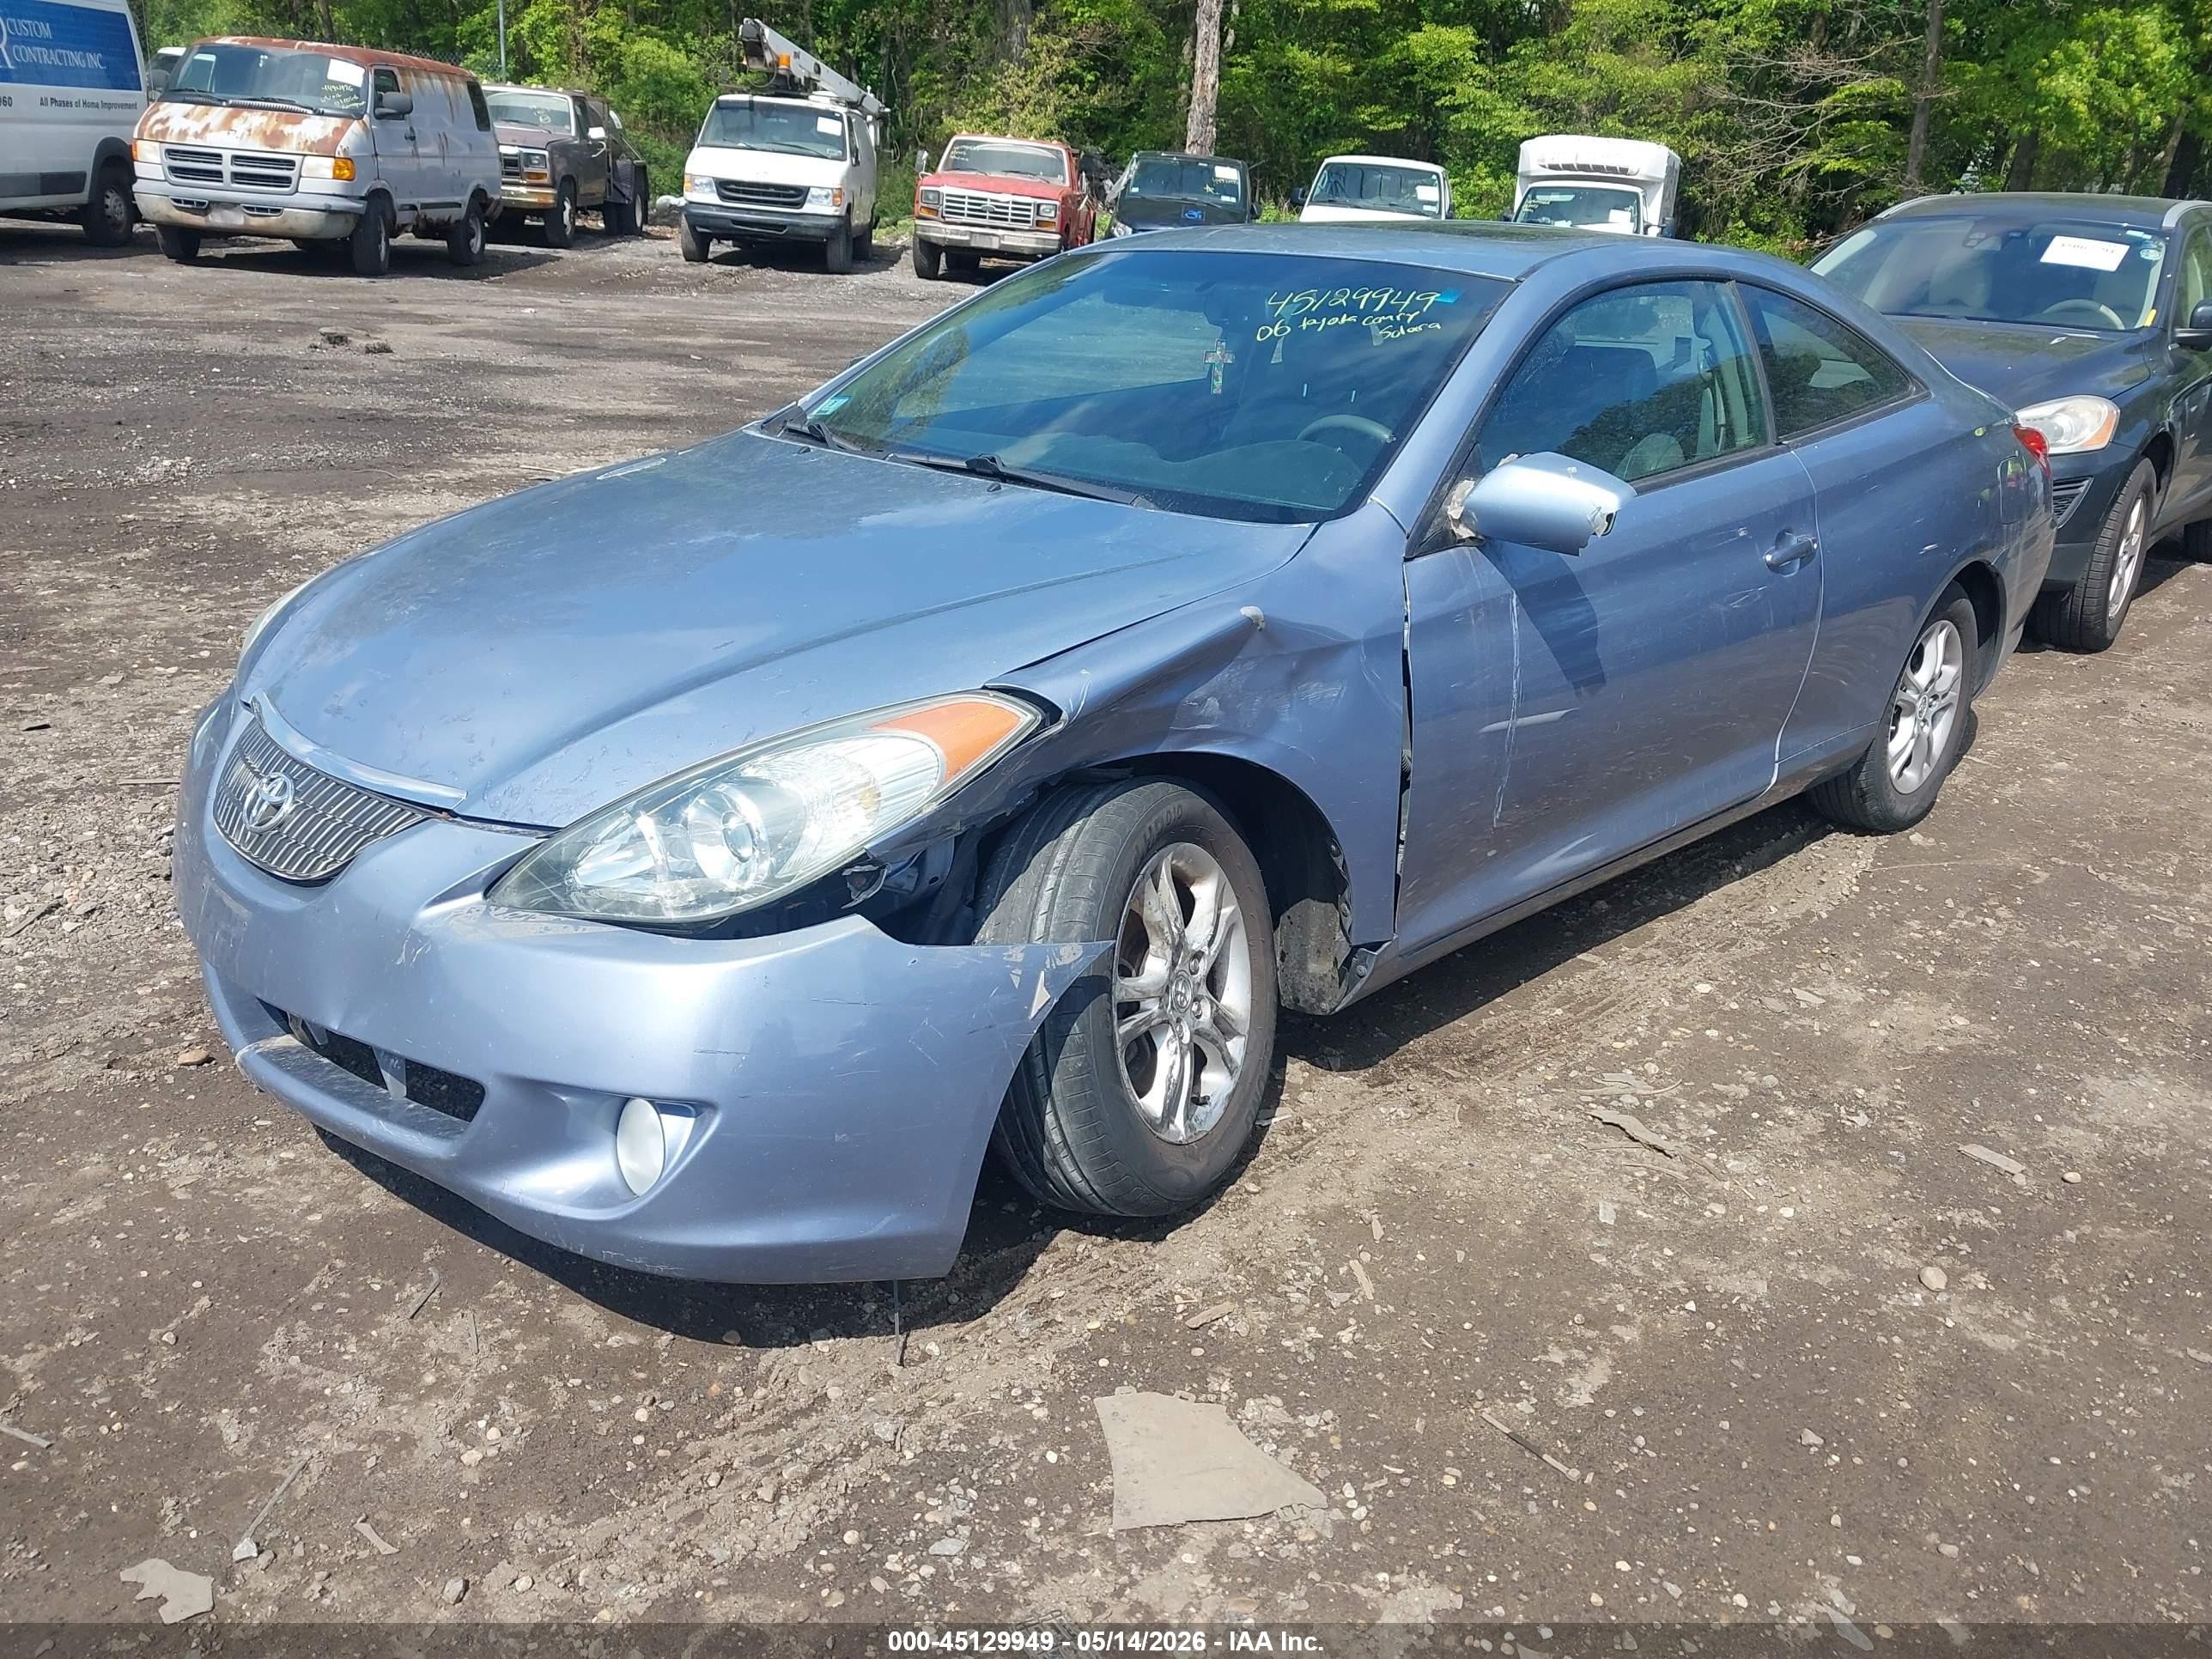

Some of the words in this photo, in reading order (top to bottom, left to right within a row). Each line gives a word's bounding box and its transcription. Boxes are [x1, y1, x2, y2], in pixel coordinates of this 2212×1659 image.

[7, 18, 52, 40] CUSTOM
[13, 45, 86, 69] CONTRACTING
[86, 52, 106, 70] INC.
[0, 95, 13, 107] 60
[40, 96, 48, 106] All
[50, 97, 73, 108] Phases
[75, 99, 81, 108] of
[82, 99, 99, 109] Home
[100, 100, 137, 110] Improvement
[1267, 288, 1441, 317] 45129949
[1256, 319, 1291, 342] 06
